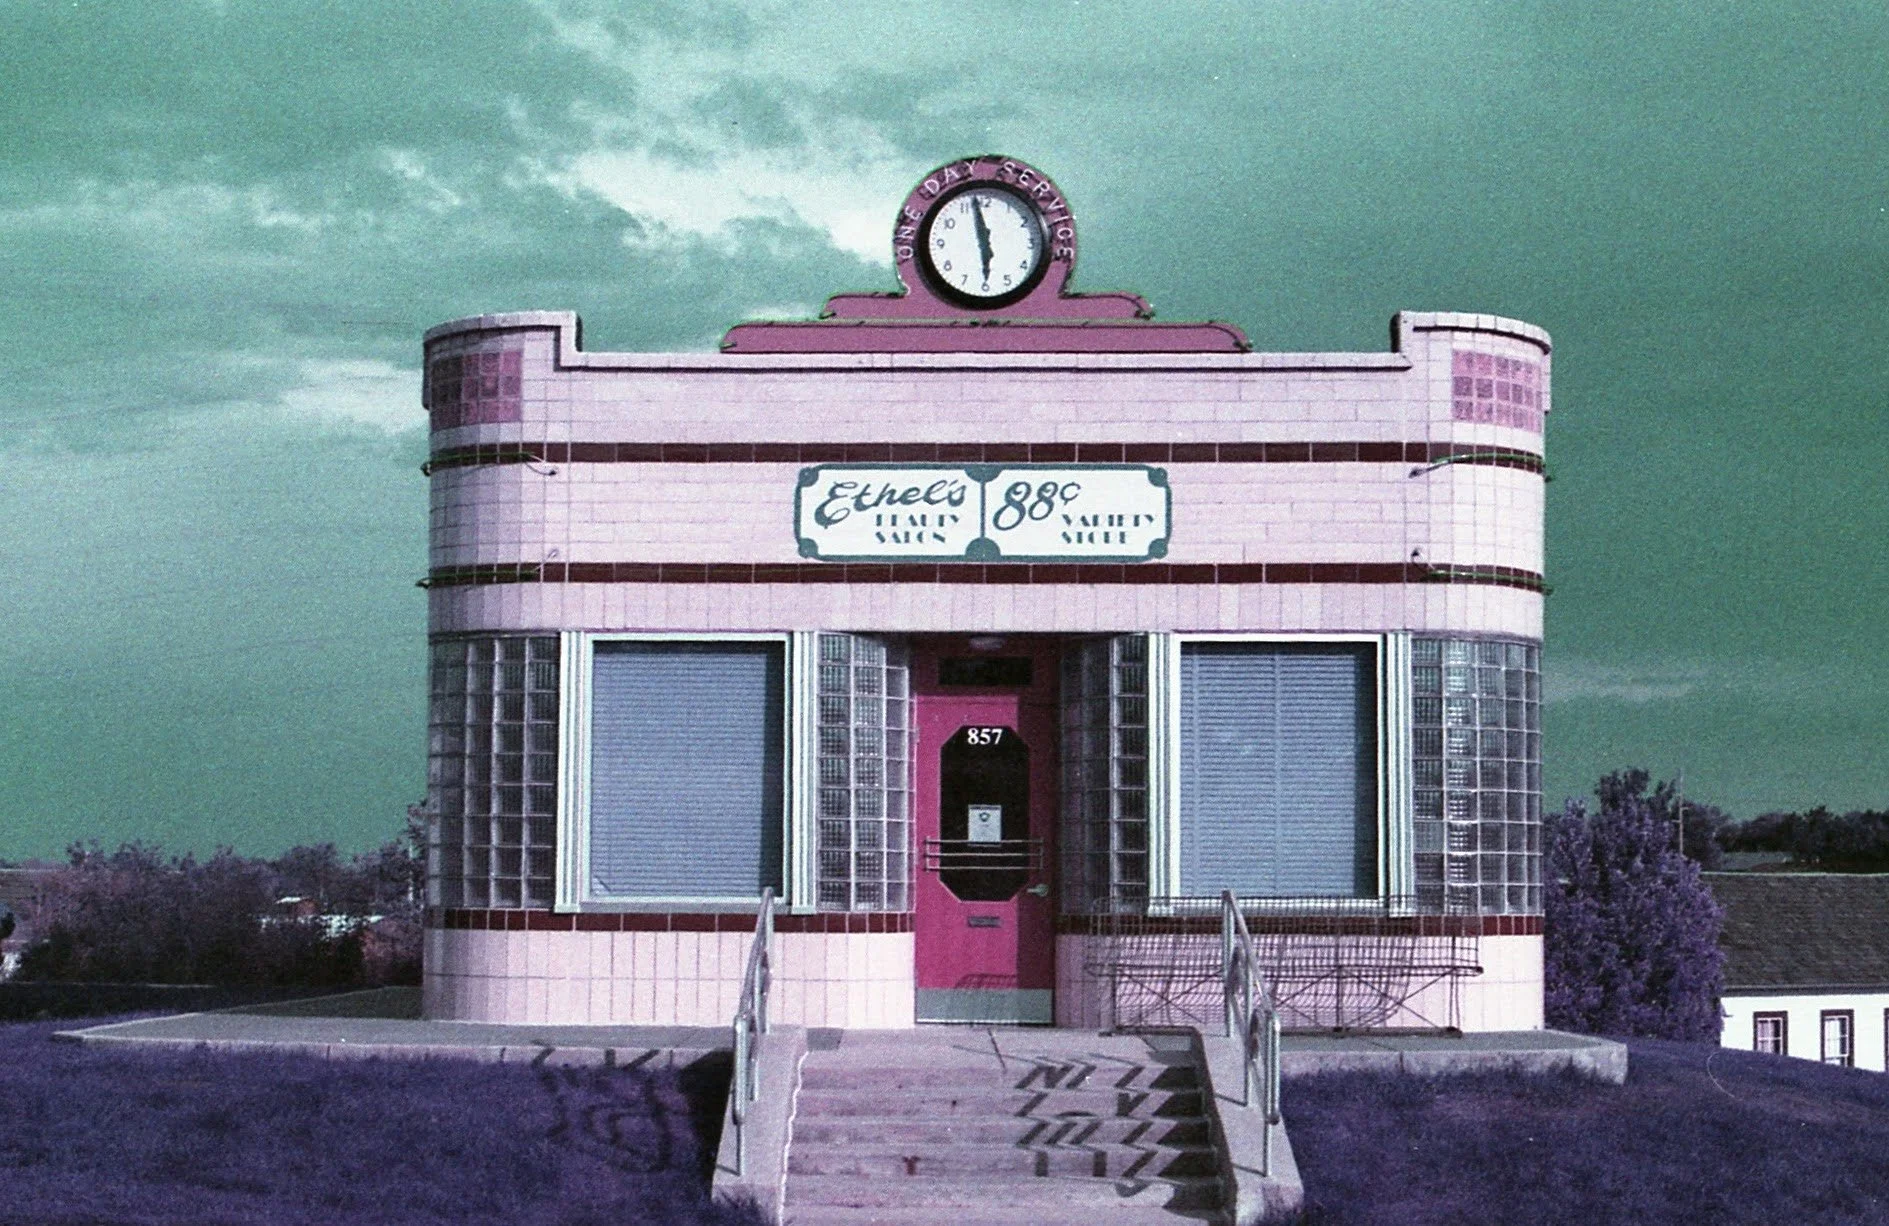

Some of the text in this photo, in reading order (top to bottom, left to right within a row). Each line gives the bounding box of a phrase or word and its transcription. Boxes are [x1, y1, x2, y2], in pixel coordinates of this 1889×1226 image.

[897, 160, 1075, 259] ONE DAY SERVICE
[944, 217, 956, 230] 10
[1020, 216, 1029, 228] 2
[936, 238, 945, 250] 9
[1020, 260, 1028, 270] 4
[960, 274, 969, 286] 7
[1003, 274, 1012, 286] 5
[981, 281, 990, 292] 6
[814, 479, 967, 529] Ethel's
[967, 727, 1003, 745] 857
